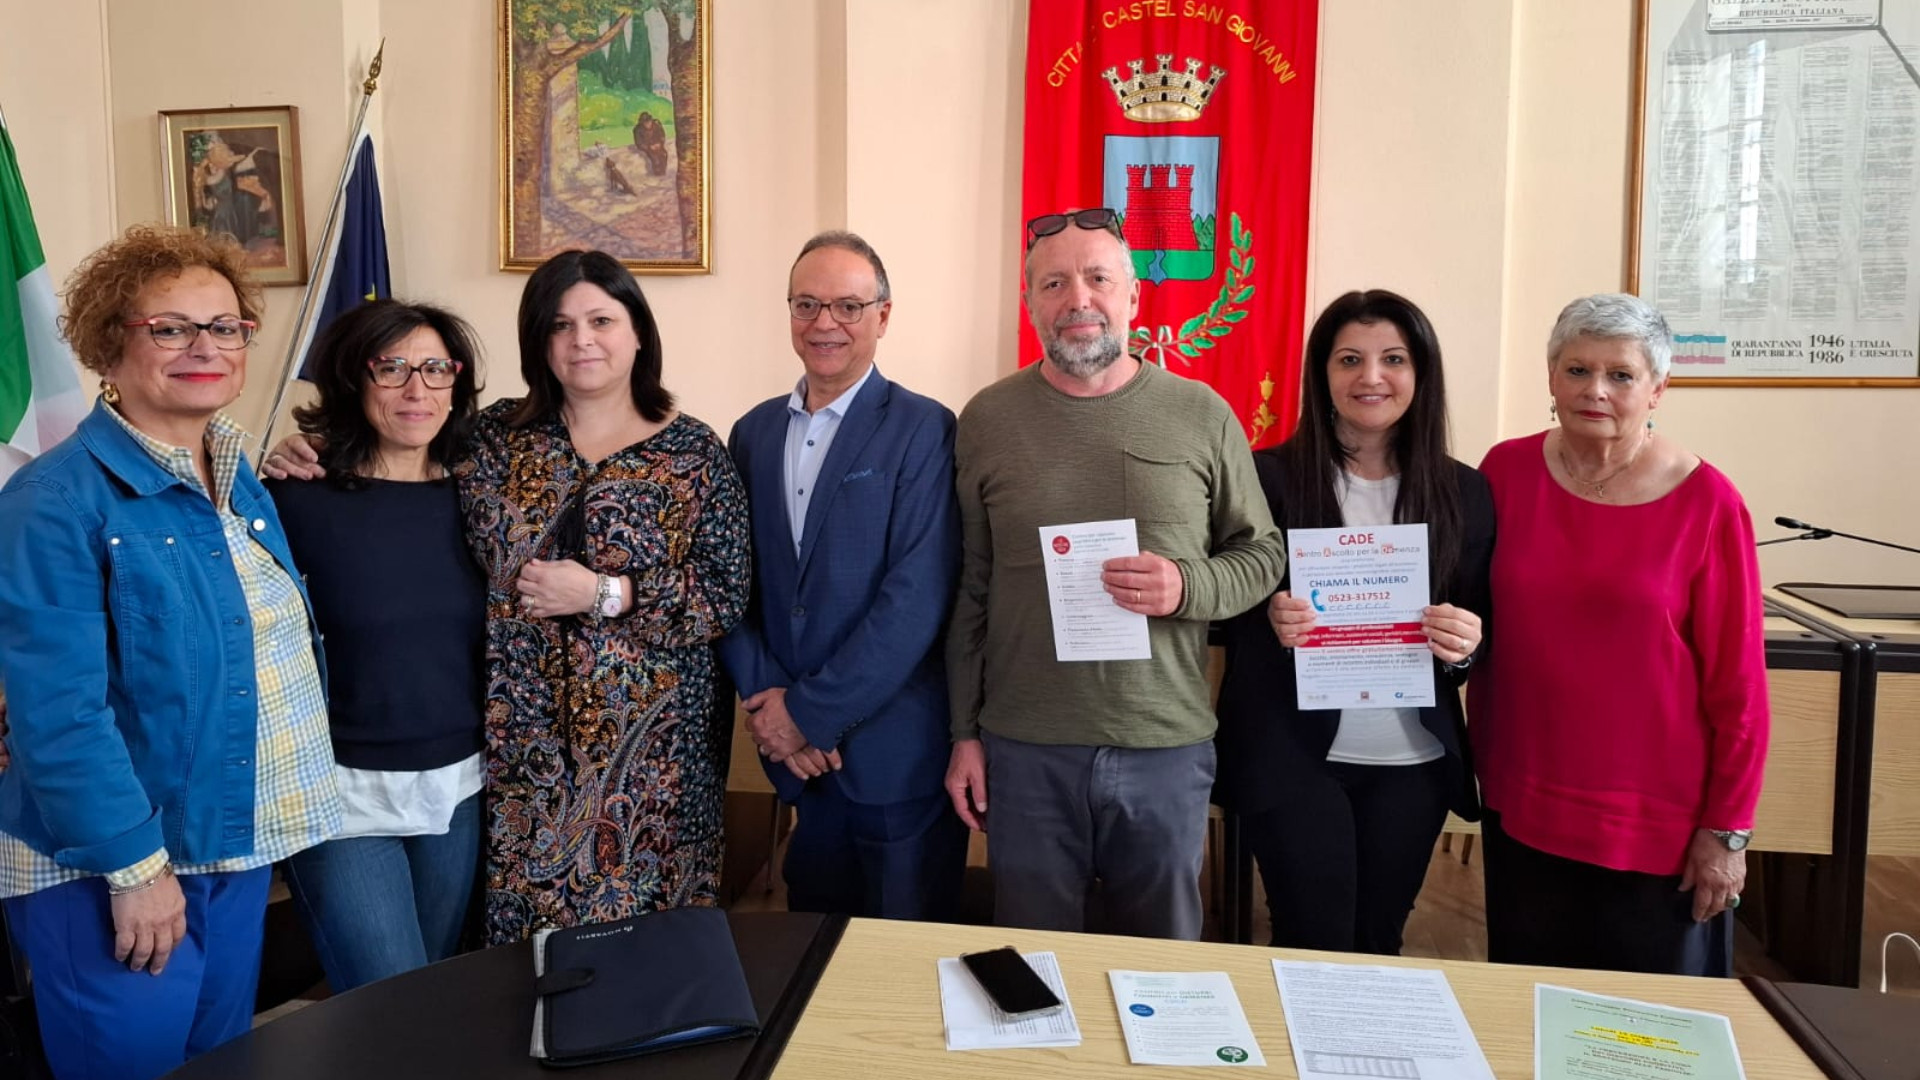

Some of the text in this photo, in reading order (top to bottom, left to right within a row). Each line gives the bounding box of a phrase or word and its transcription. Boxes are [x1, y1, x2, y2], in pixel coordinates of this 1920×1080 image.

[1800, 7, 1844, 15] ITALIANA
[1102, 0, 1177, 29] CASTEL
[1182, 0, 1224, 25] SAN
[1225, 14, 1297, 84] GIOVANNI
[1731, 340, 1802, 349] QUARANT'ANNI
[1809, 334, 1845, 348] 1946
[1850, 340, 1891, 348] L'ITALIA
[1731, 350, 1804, 358] DI REPUBBLICA
[1808, 350, 1845, 364] 1986
[1859, 349, 1914, 357] CRESCIUTA
[1338, 533, 1375, 546] CADE
[1309, 575, 1409, 588] CHIAMA IL NUMERO
[1328, 591, 1391, 602] 0523-317512
